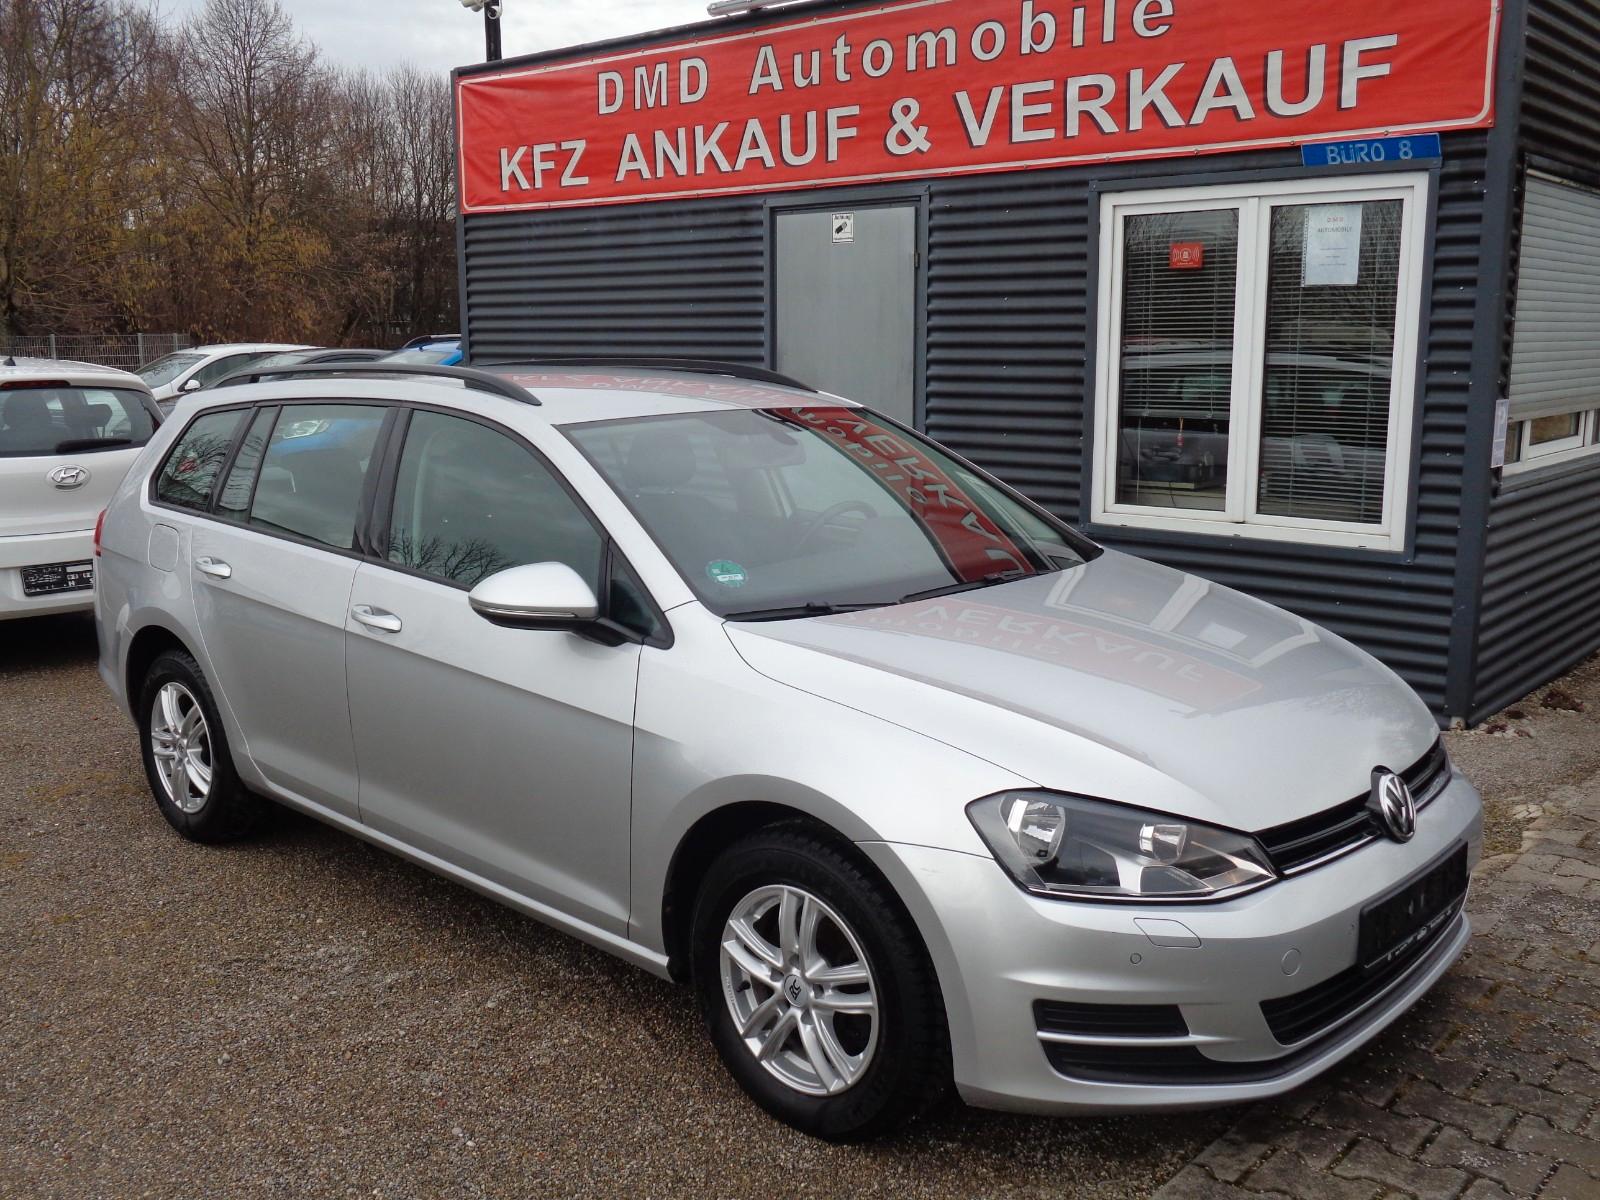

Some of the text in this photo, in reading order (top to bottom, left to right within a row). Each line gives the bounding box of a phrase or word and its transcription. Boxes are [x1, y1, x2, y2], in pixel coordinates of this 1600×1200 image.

[499, 33, 1398, 192] KFZ ANKAUF & VERKAUF
[598, 0, 1175, 116] DMD Automobile
[1325, 140, 1413, 165] BÜRO 8
